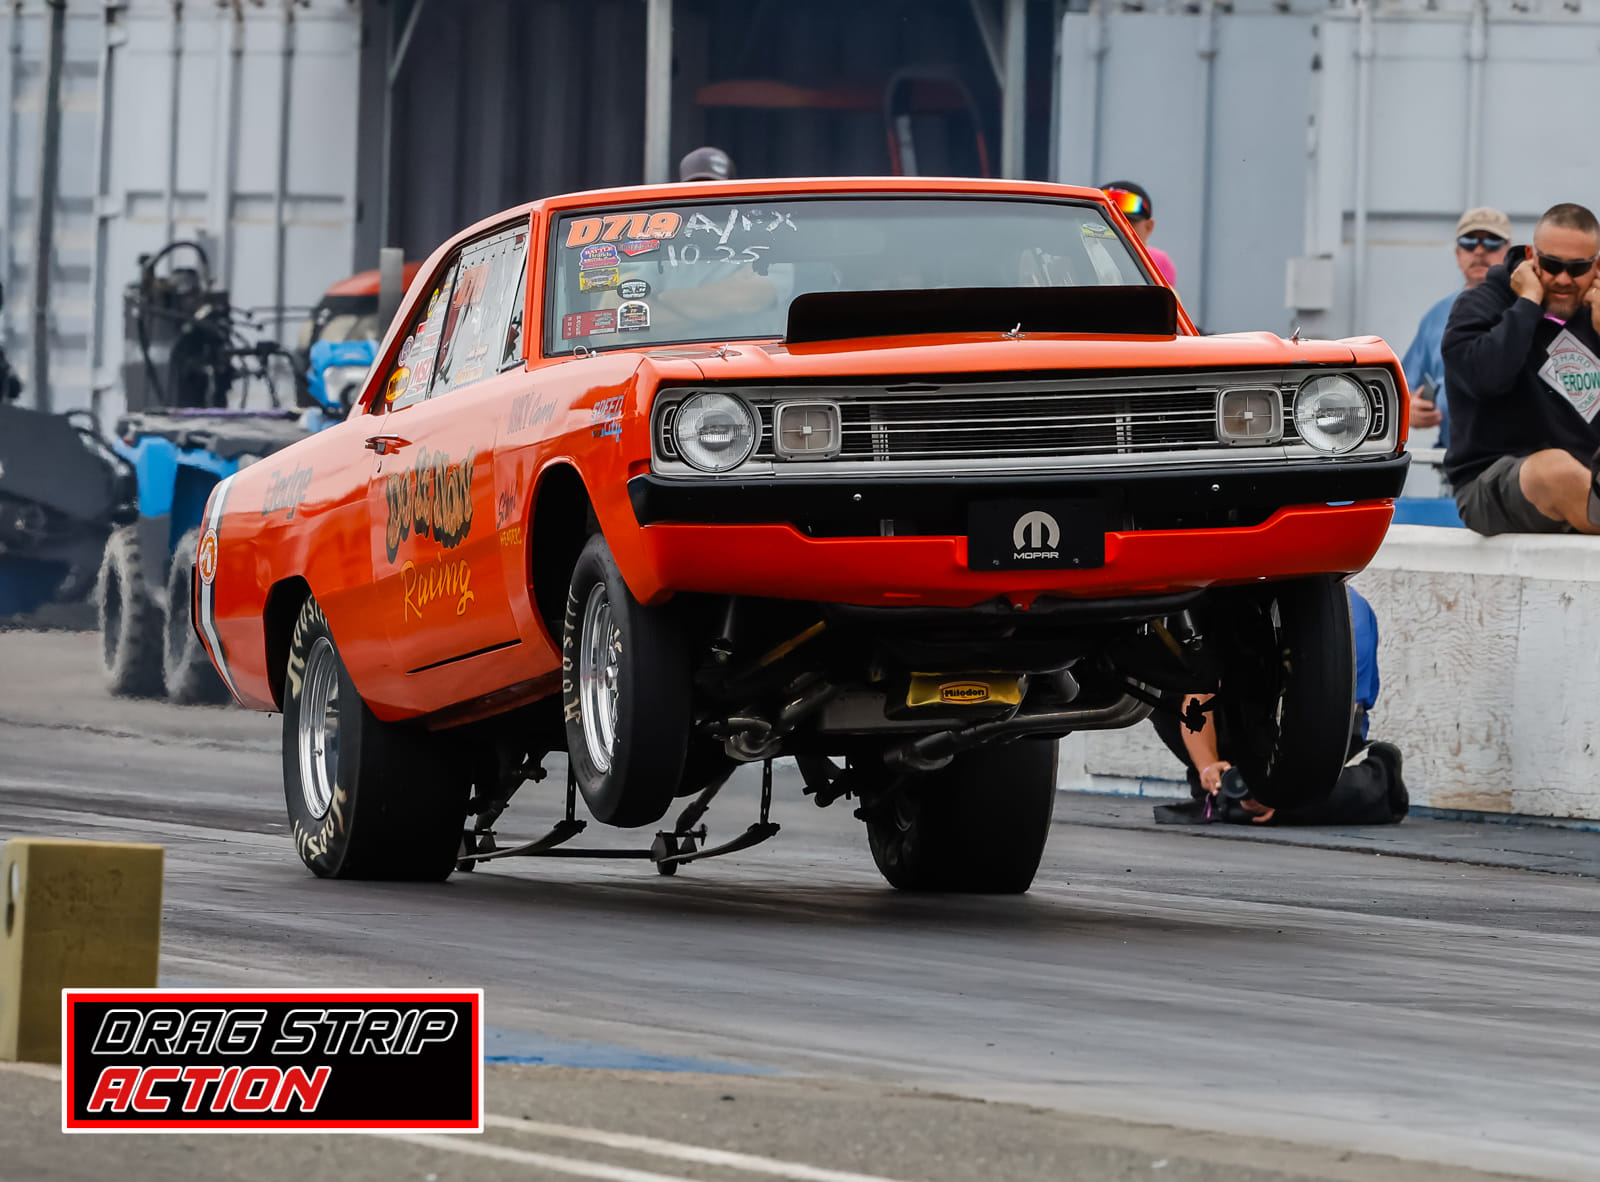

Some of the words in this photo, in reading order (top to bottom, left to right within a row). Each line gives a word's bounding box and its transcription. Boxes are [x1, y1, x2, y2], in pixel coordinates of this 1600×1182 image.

[566, 212, 682, 248] D719
[667, 244, 771, 267] 10.25
[1013, 551, 1059, 560] MOPAR
[401, 552, 475, 623] Racing
[944, 689, 984, 698] Milodon
